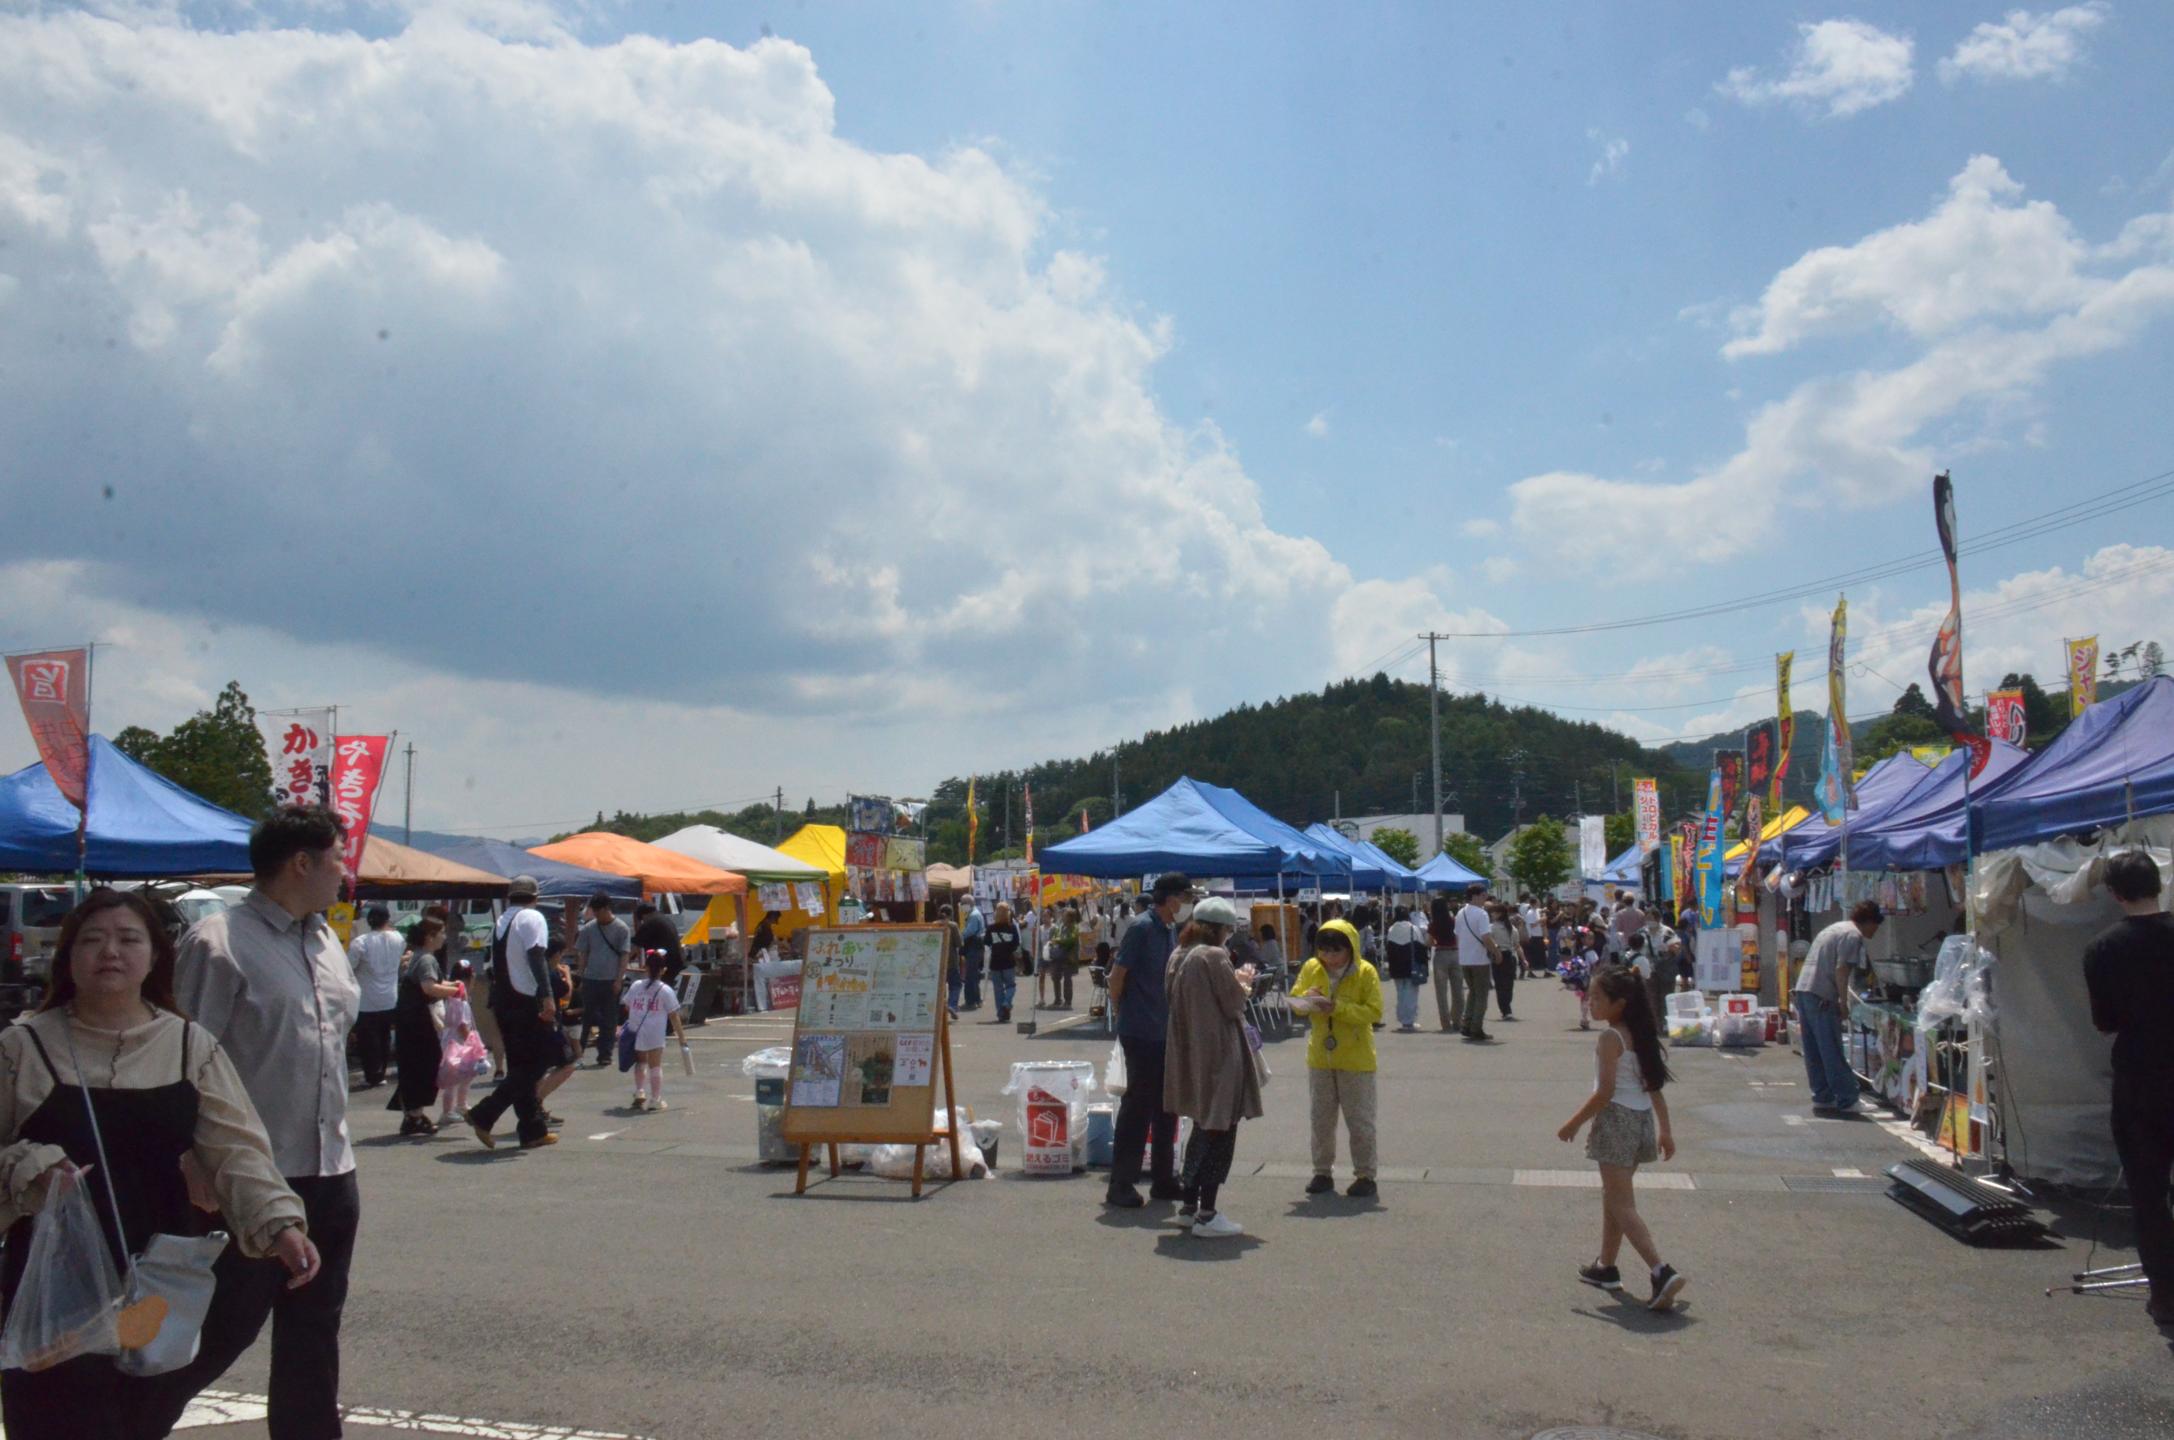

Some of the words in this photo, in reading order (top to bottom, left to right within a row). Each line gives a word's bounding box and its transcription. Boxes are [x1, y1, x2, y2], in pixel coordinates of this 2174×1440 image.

[2074, 647, 2092, 704] ジャ
[283, 722, 318, 806] かき
[1649, 797, 1657, 840] トロピカル
[822, 955, 854, 967] まつり
